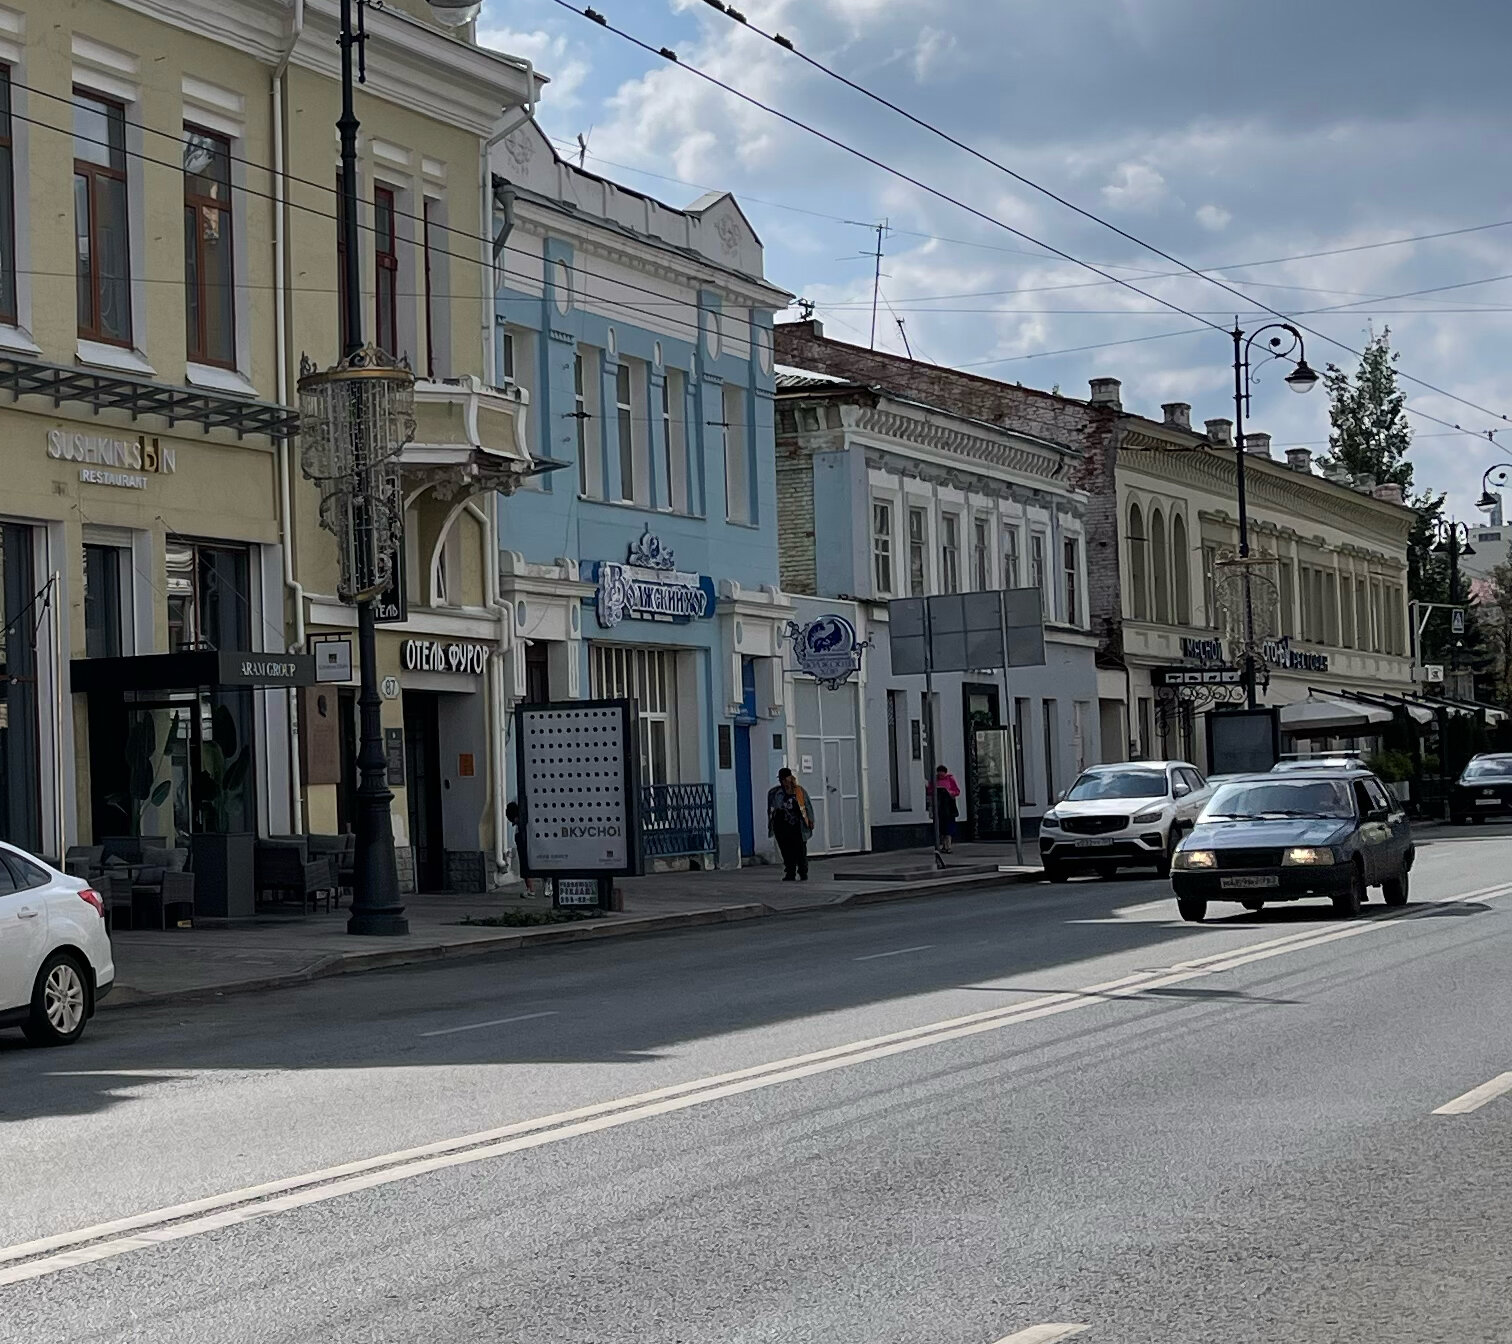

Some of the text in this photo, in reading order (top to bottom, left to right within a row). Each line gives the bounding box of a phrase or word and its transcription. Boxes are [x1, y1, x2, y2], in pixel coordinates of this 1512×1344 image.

[79, 469, 148, 489] RESTAURANT
[374, 604, 399, 618] ТЕЛЬ
[406, 639, 490, 674] ОТЕЛЬ ФУРОР
[242, 661, 297, 677] ARAM GROUP
[385, 679, 396, 696] 87
